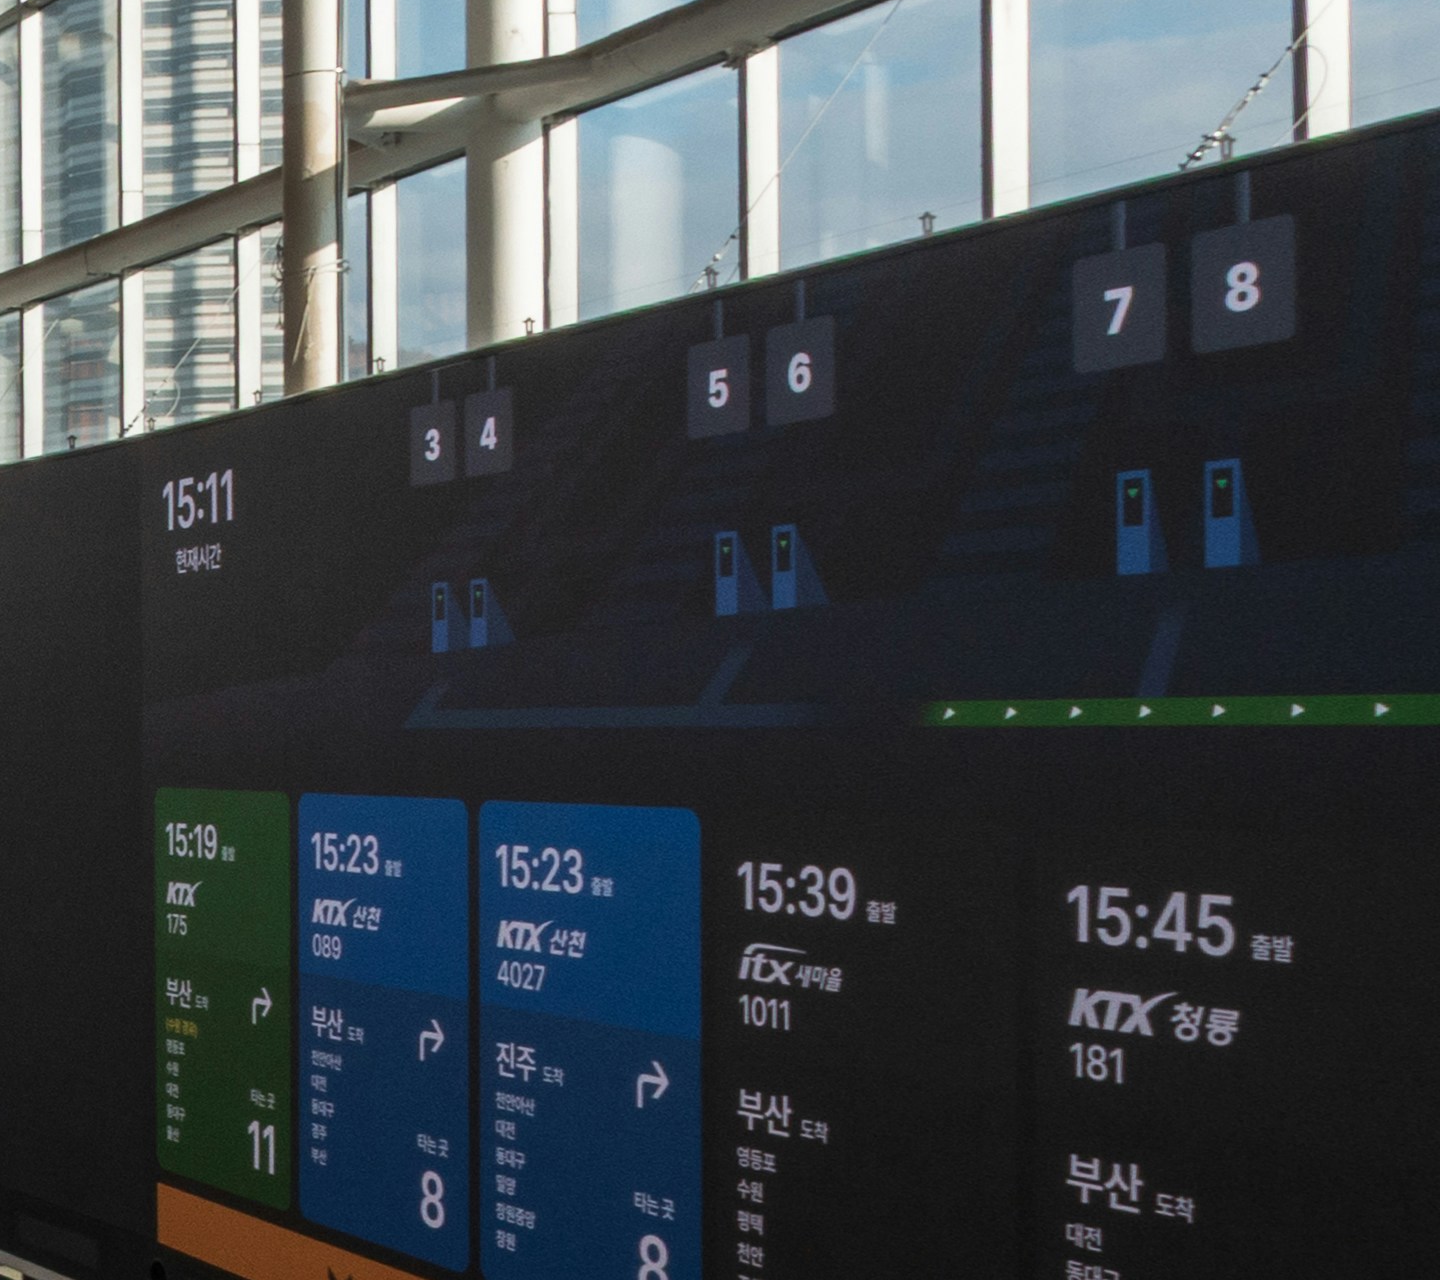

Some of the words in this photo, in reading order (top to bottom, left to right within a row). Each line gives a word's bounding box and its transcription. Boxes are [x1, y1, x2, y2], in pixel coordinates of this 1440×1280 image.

[1226, 262, 1261, 313] 8
[1102, 286, 1133, 337] 7
[707, 369, 730, 408] 5
[787, 353, 811, 392] 6
[424, 429, 442, 462] 3
[479, 418, 498, 452] 4
[162, 468, 236, 534] 15:11
[175, 544, 222, 573] 현재시간
[165, 821, 218, 861] 15:19
[311, 831, 380, 874] 15:23
[495, 843, 583, 894] 15:23
[166, 881, 203, 908] KTX
[737, 860, 857, 922] 15:39
[166, 912, 188, 936] 175
[312, 898, 357, 928] KTX
[353, 904, 381, 932] 산천
[1066, 884, 1235, 957] 15:45
[1249, 933, 1294, 963] 출발
[312, 933, 342, 960] 089
[497, 920, 554, 954] KTX
[549, 928, 587, 959] 산천
[166, 977, 192, 1010] 부산
[497, 960, 545, 993] 4027
[795, 963, 844, 993] 새마을
[311, 1005, 344, 1042] 부산
[347, 1027, 365, 1044] 도착
[738, 994, 791, 1031] 1011
[1068, 988, 1179, 1038] KTX
[1170, 1000, 1240, 1046] 청룡
[496, 1041, 537, 1083] 진주
[543, 1066, 565, 1087] 도착
[1068, 1042, 1124, 1085] 181
[495, 1120, 516, 1141] 대전
[737, 1088, 792, 1138] 부산
[800, 1117, 829, 1144] 도착
[247, 1120, 275, 1176] 11
[737, 1146, 777, 1174] 영등포
[420, 1170, 445, 1230] 8
[737, 1179, 764, 1203] 수원
[1066, 1154, 1143, 1214] 부산
[1155, 1192, 1196, 1225] 도착
[1065, 1222, 1103, 1253] 대전
